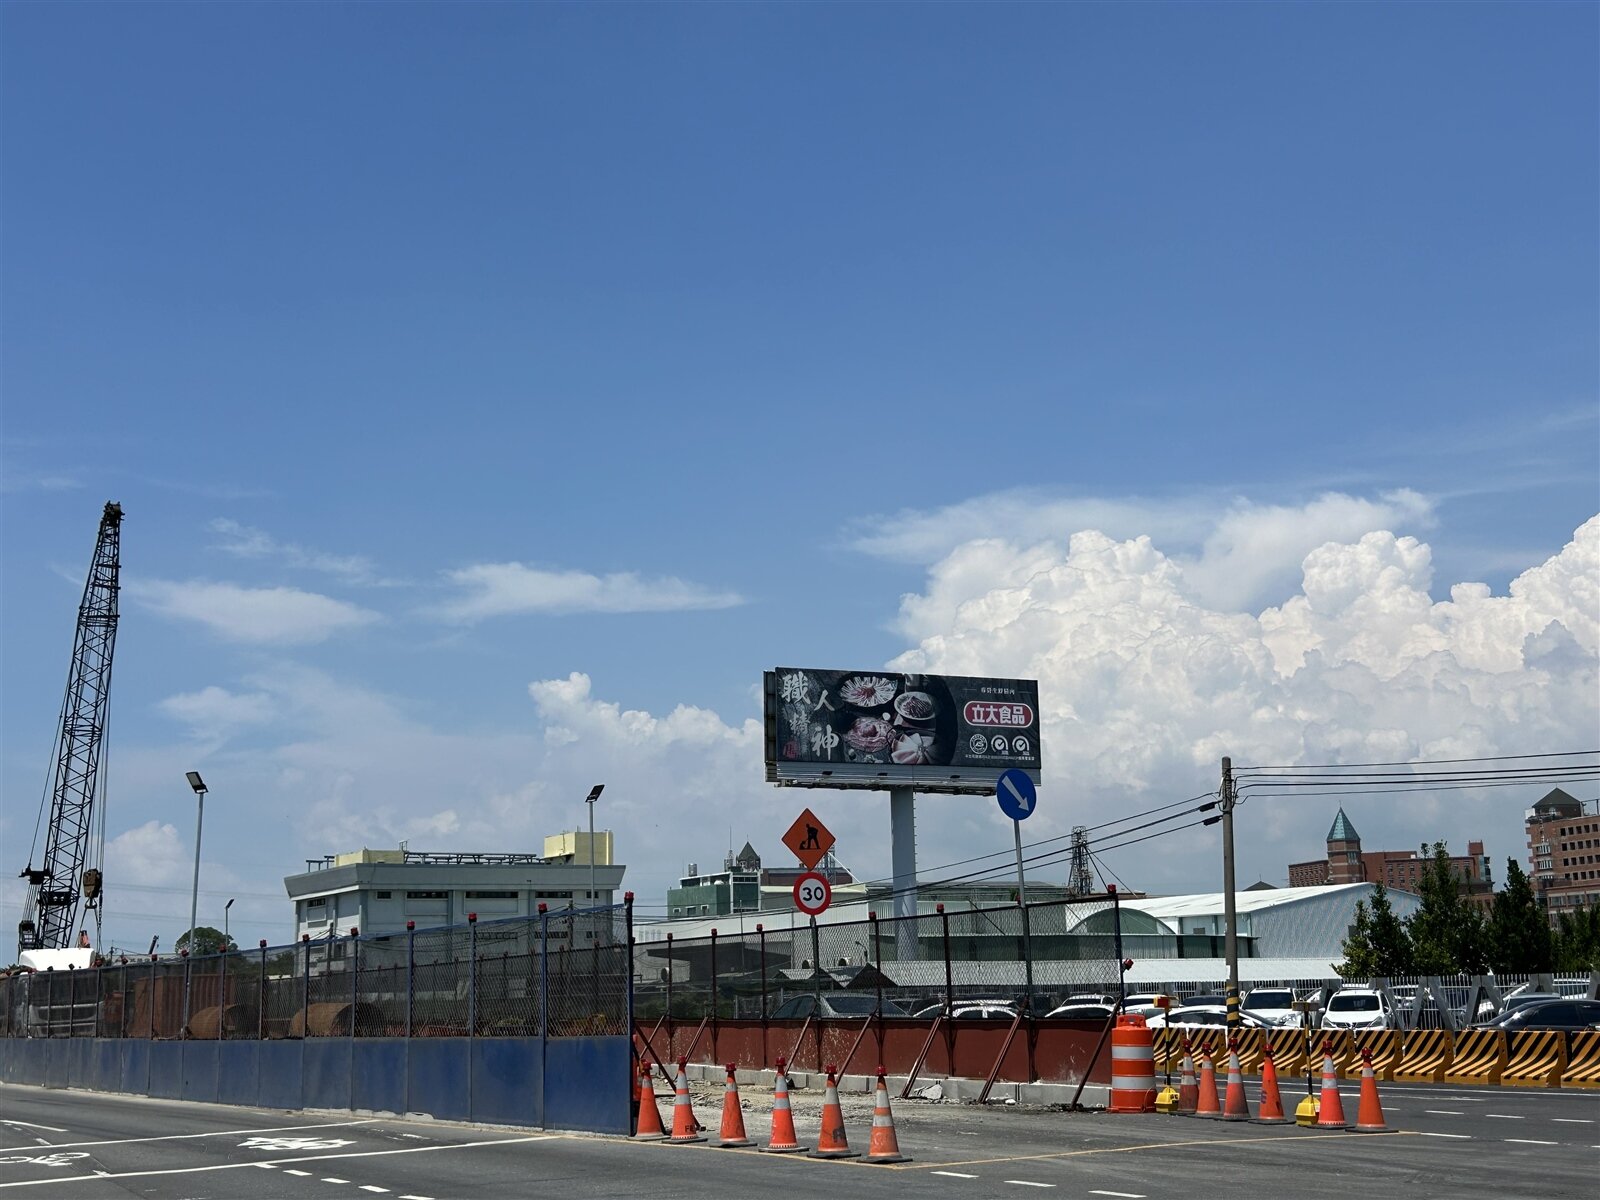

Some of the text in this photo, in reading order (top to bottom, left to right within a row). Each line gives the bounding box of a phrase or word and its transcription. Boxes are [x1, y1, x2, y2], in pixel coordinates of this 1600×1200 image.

[781, 671, 834, 711] 職人
[972, 704, 1025, 724] 立大食品
[789, 710, 839, 761] 精神
[802, 886, 823, 901] 30
